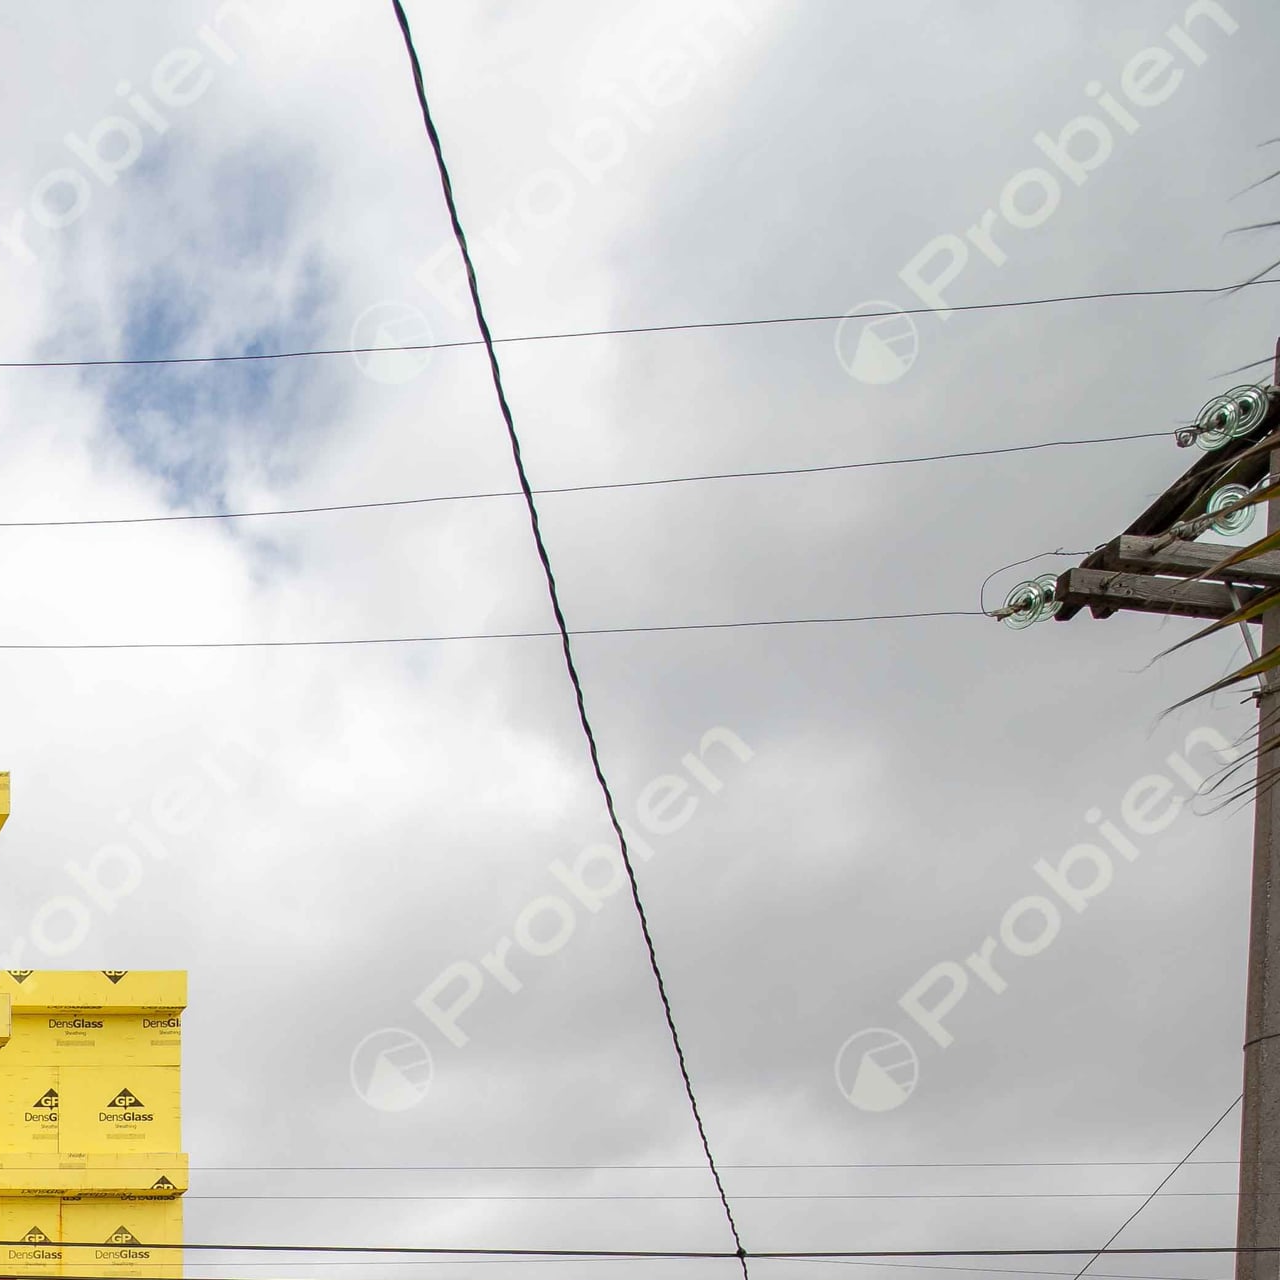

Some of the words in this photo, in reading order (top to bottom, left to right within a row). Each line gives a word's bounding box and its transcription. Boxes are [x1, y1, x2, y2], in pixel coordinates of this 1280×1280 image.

[48, 1019, 103, 1029] DensGlass
[114, 1096, 136, 1107] GP
[99, 1112, 153, 1122] DensGlass
[24, 1233, 46, 1243] GP
[111, 1233, 132, 1243] GP
[8, 1250, 62, 1260] DensGlass
[95, 1250, 150, 1260] DensGlass
